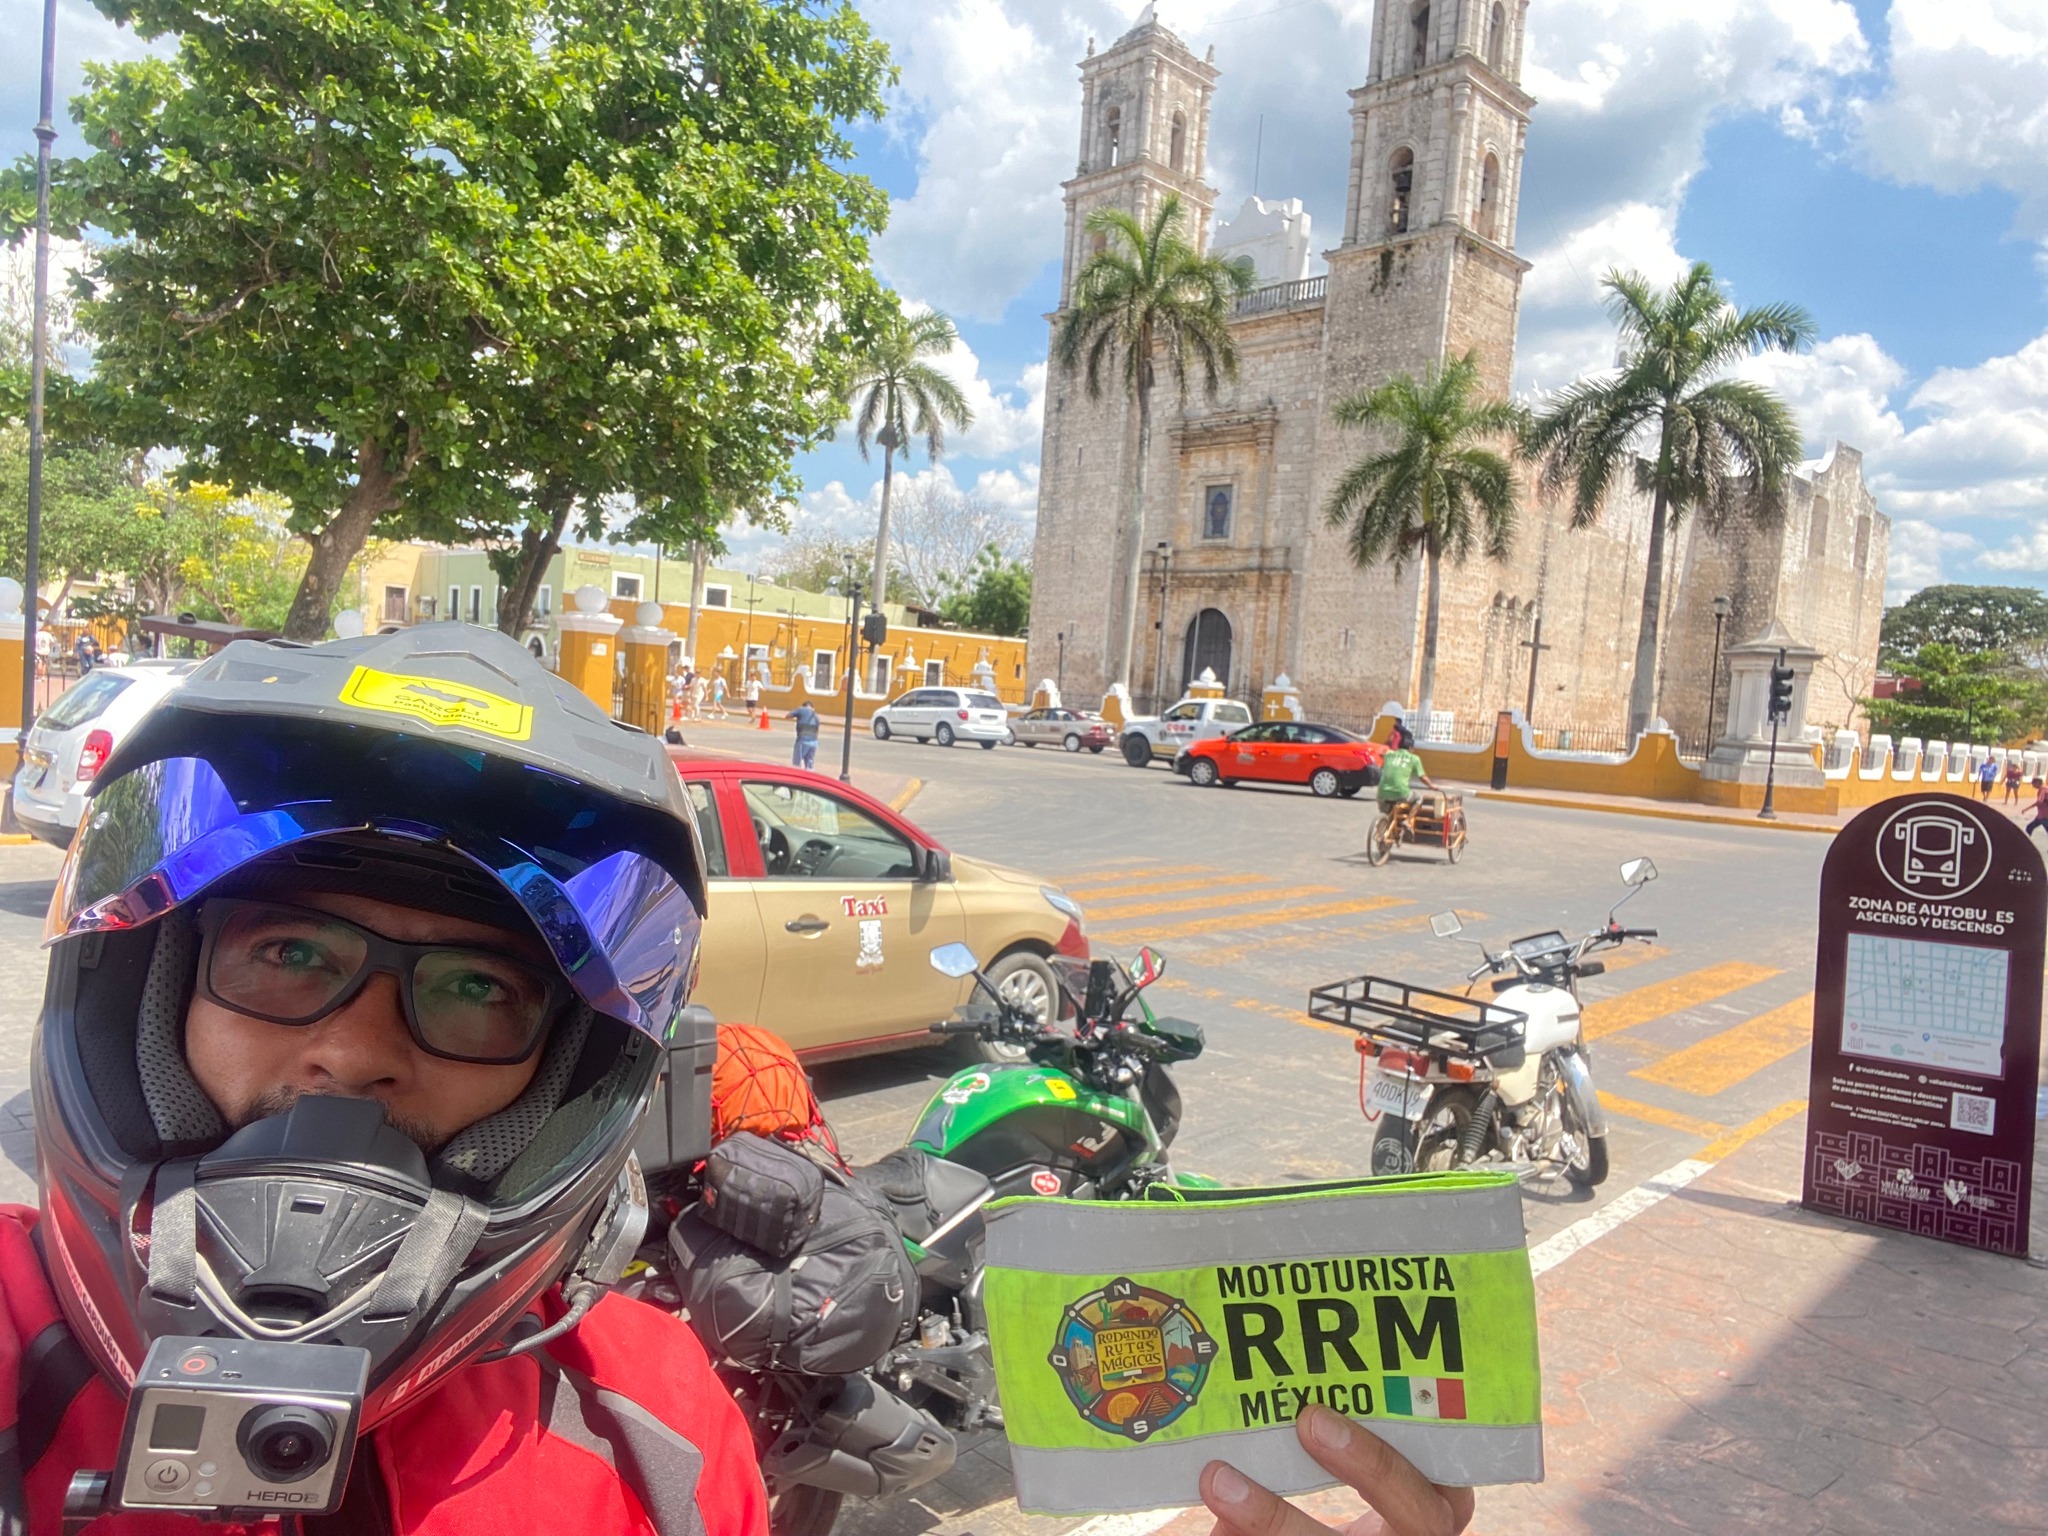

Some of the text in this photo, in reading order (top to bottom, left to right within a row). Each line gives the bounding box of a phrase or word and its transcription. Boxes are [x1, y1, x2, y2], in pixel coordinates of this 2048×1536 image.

[840, 893, 888, 917] Taxi
[1848, 896, 2015, 924] ZONA DE AUTOBUES
[1856, 911, 2005, 936] ASCENSO Y DESCENSO
[1113, 1282, 1131, 1296] N
[1217, 1256, 1456, 1299] MOTOTURISTA
[1197, 1341, 1212, 1354] E
[1223, 1295, 1464, 1382] RRM
[1240, 1381, 1374, 1428] MÉXICO
[1133, 1420, 1149, 1434] S
[153, 1483, 178, 1491] mode
